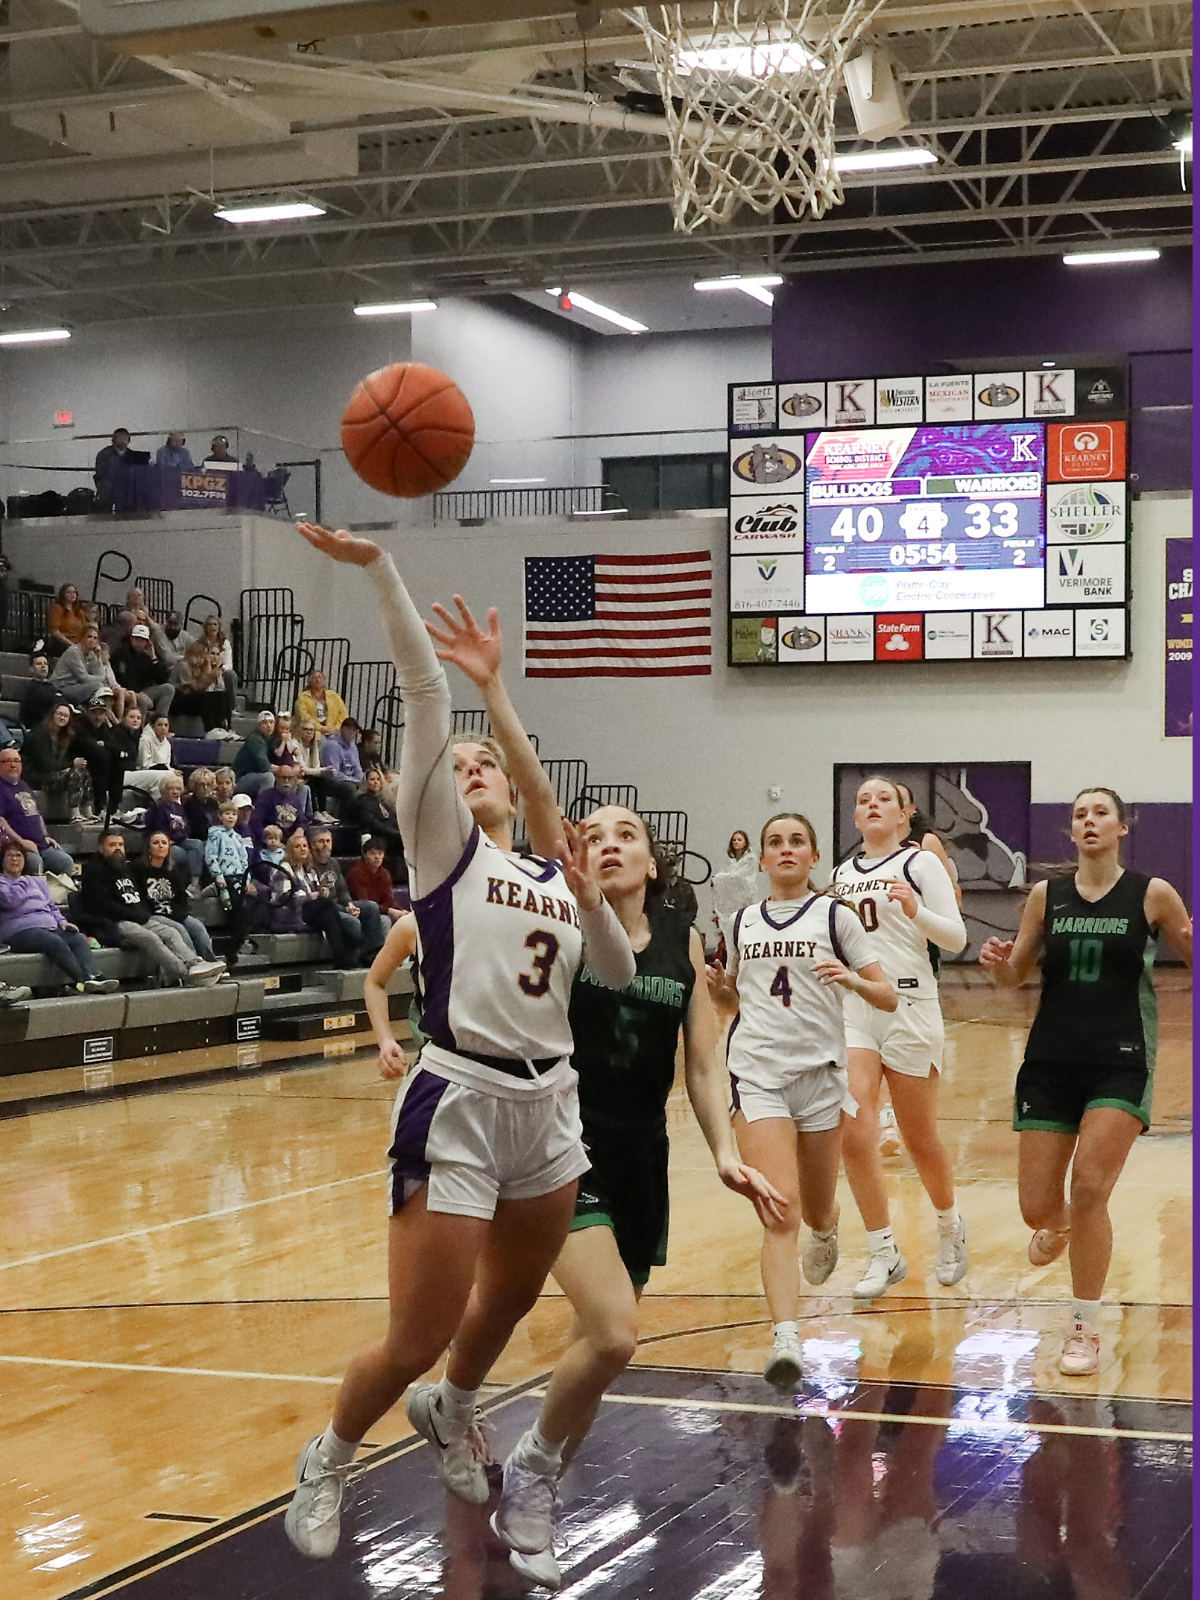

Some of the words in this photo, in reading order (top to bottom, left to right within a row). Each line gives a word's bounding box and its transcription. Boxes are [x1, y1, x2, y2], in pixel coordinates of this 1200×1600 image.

[929, 389, 970, 397] MEXICAN
[823, 442, 889, 455] KEARNEY
[1011, 435, 1037, 462] K
[826, 454, 853, 464] SCHOOL
[855, 453, 887, 463] DISTRICT
[1064, 453, 1108, 462] KEARNEY
[181, 474, 227, 491] KPGZ
[812, 482, 893, 498] BULLDOGS
[955, 476, 1038, 493] WARRIORS
[1050, 505, 1121, 518] SHELLER
[735, 515, 798, 534] Club
[830, 506, 884, 543] 40
[917, 515, 929, 533] 4
[964, 502, 1018, 539] 33
[733, 533, 797, 541] CARWASH
[889, 542, 958, 566] 05:54
[1012, 549, 1026, 565] 2
[823, 555, 836, 571] 2
[1059, 577, 1113, 588] VERIMORE
[1084, 587, 1112, 597] BANK
[1042, 628, 1071, 636] MAC
[1168, 652, 1193, 661] 2009
[1052, 917, 1129, 935] WARRIORS
[743, 941, 818, 961] KEARNEY
[518, 928, 561, 999] 3
[1069, 939, 1104, 982] 10
[770, 965, 793, 1008] 4
